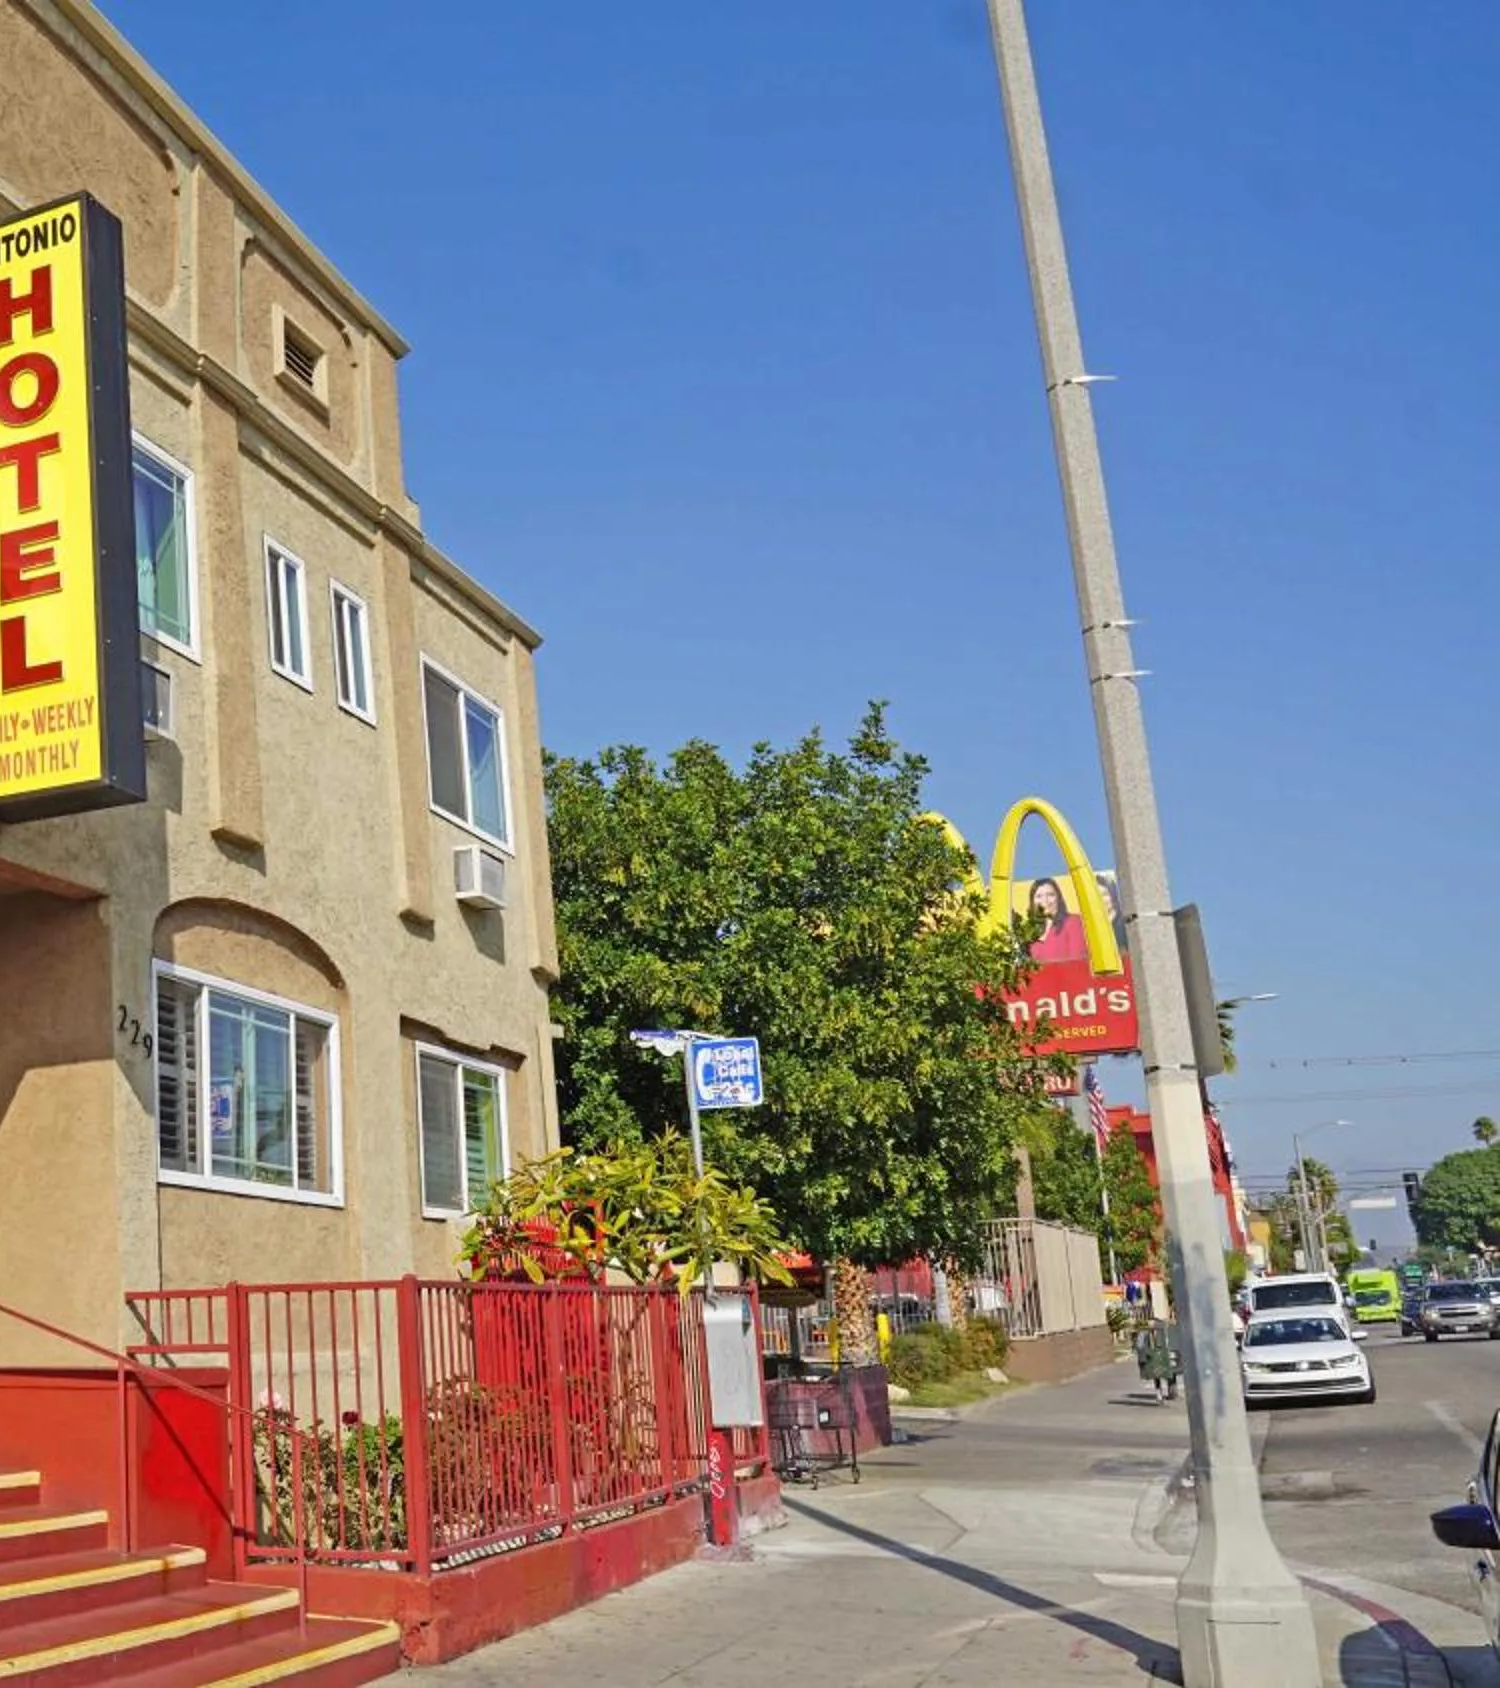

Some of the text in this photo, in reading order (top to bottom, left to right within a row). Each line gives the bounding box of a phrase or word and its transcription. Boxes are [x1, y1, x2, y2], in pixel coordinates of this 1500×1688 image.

[31, 695, 95, 737] WEEKLY
[1005, 986, 1131, 1024] nald's
[116, 1004, 153, 1059] 229
